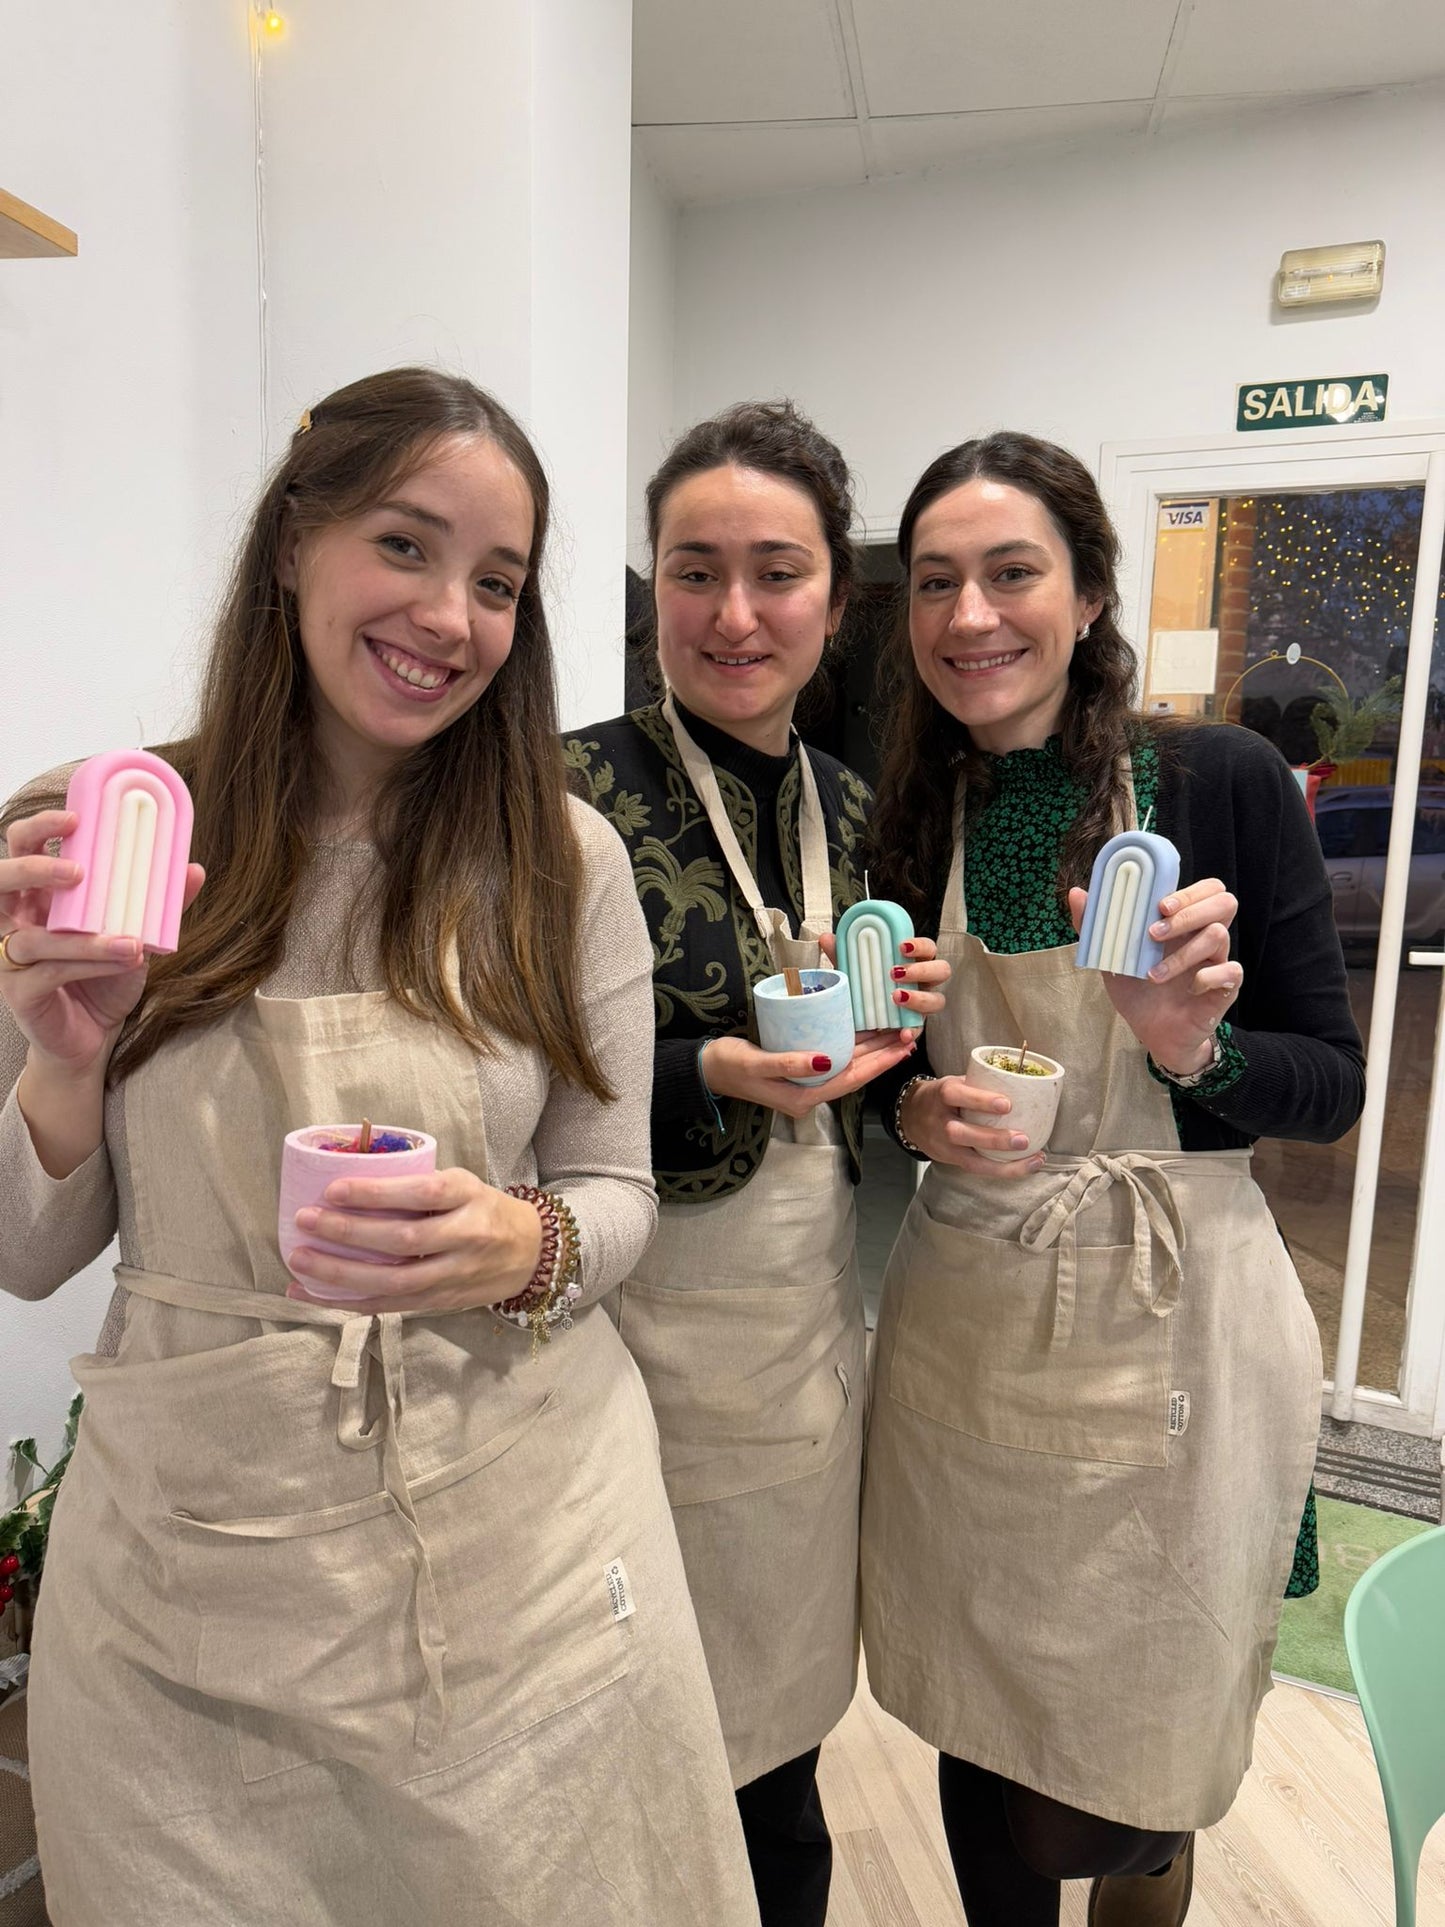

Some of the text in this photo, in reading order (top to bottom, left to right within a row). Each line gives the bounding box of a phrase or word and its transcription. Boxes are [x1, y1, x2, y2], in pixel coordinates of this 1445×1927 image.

[1243, 380, 1378, 420] SALIDA
[1168, 511, 1203, 525] VISA
[1177, 1404, 1185, 1431] COTTON
[606, 1573, 620, 1615] RECYCLED
[615, 1577, 627, 1612] COTTON
